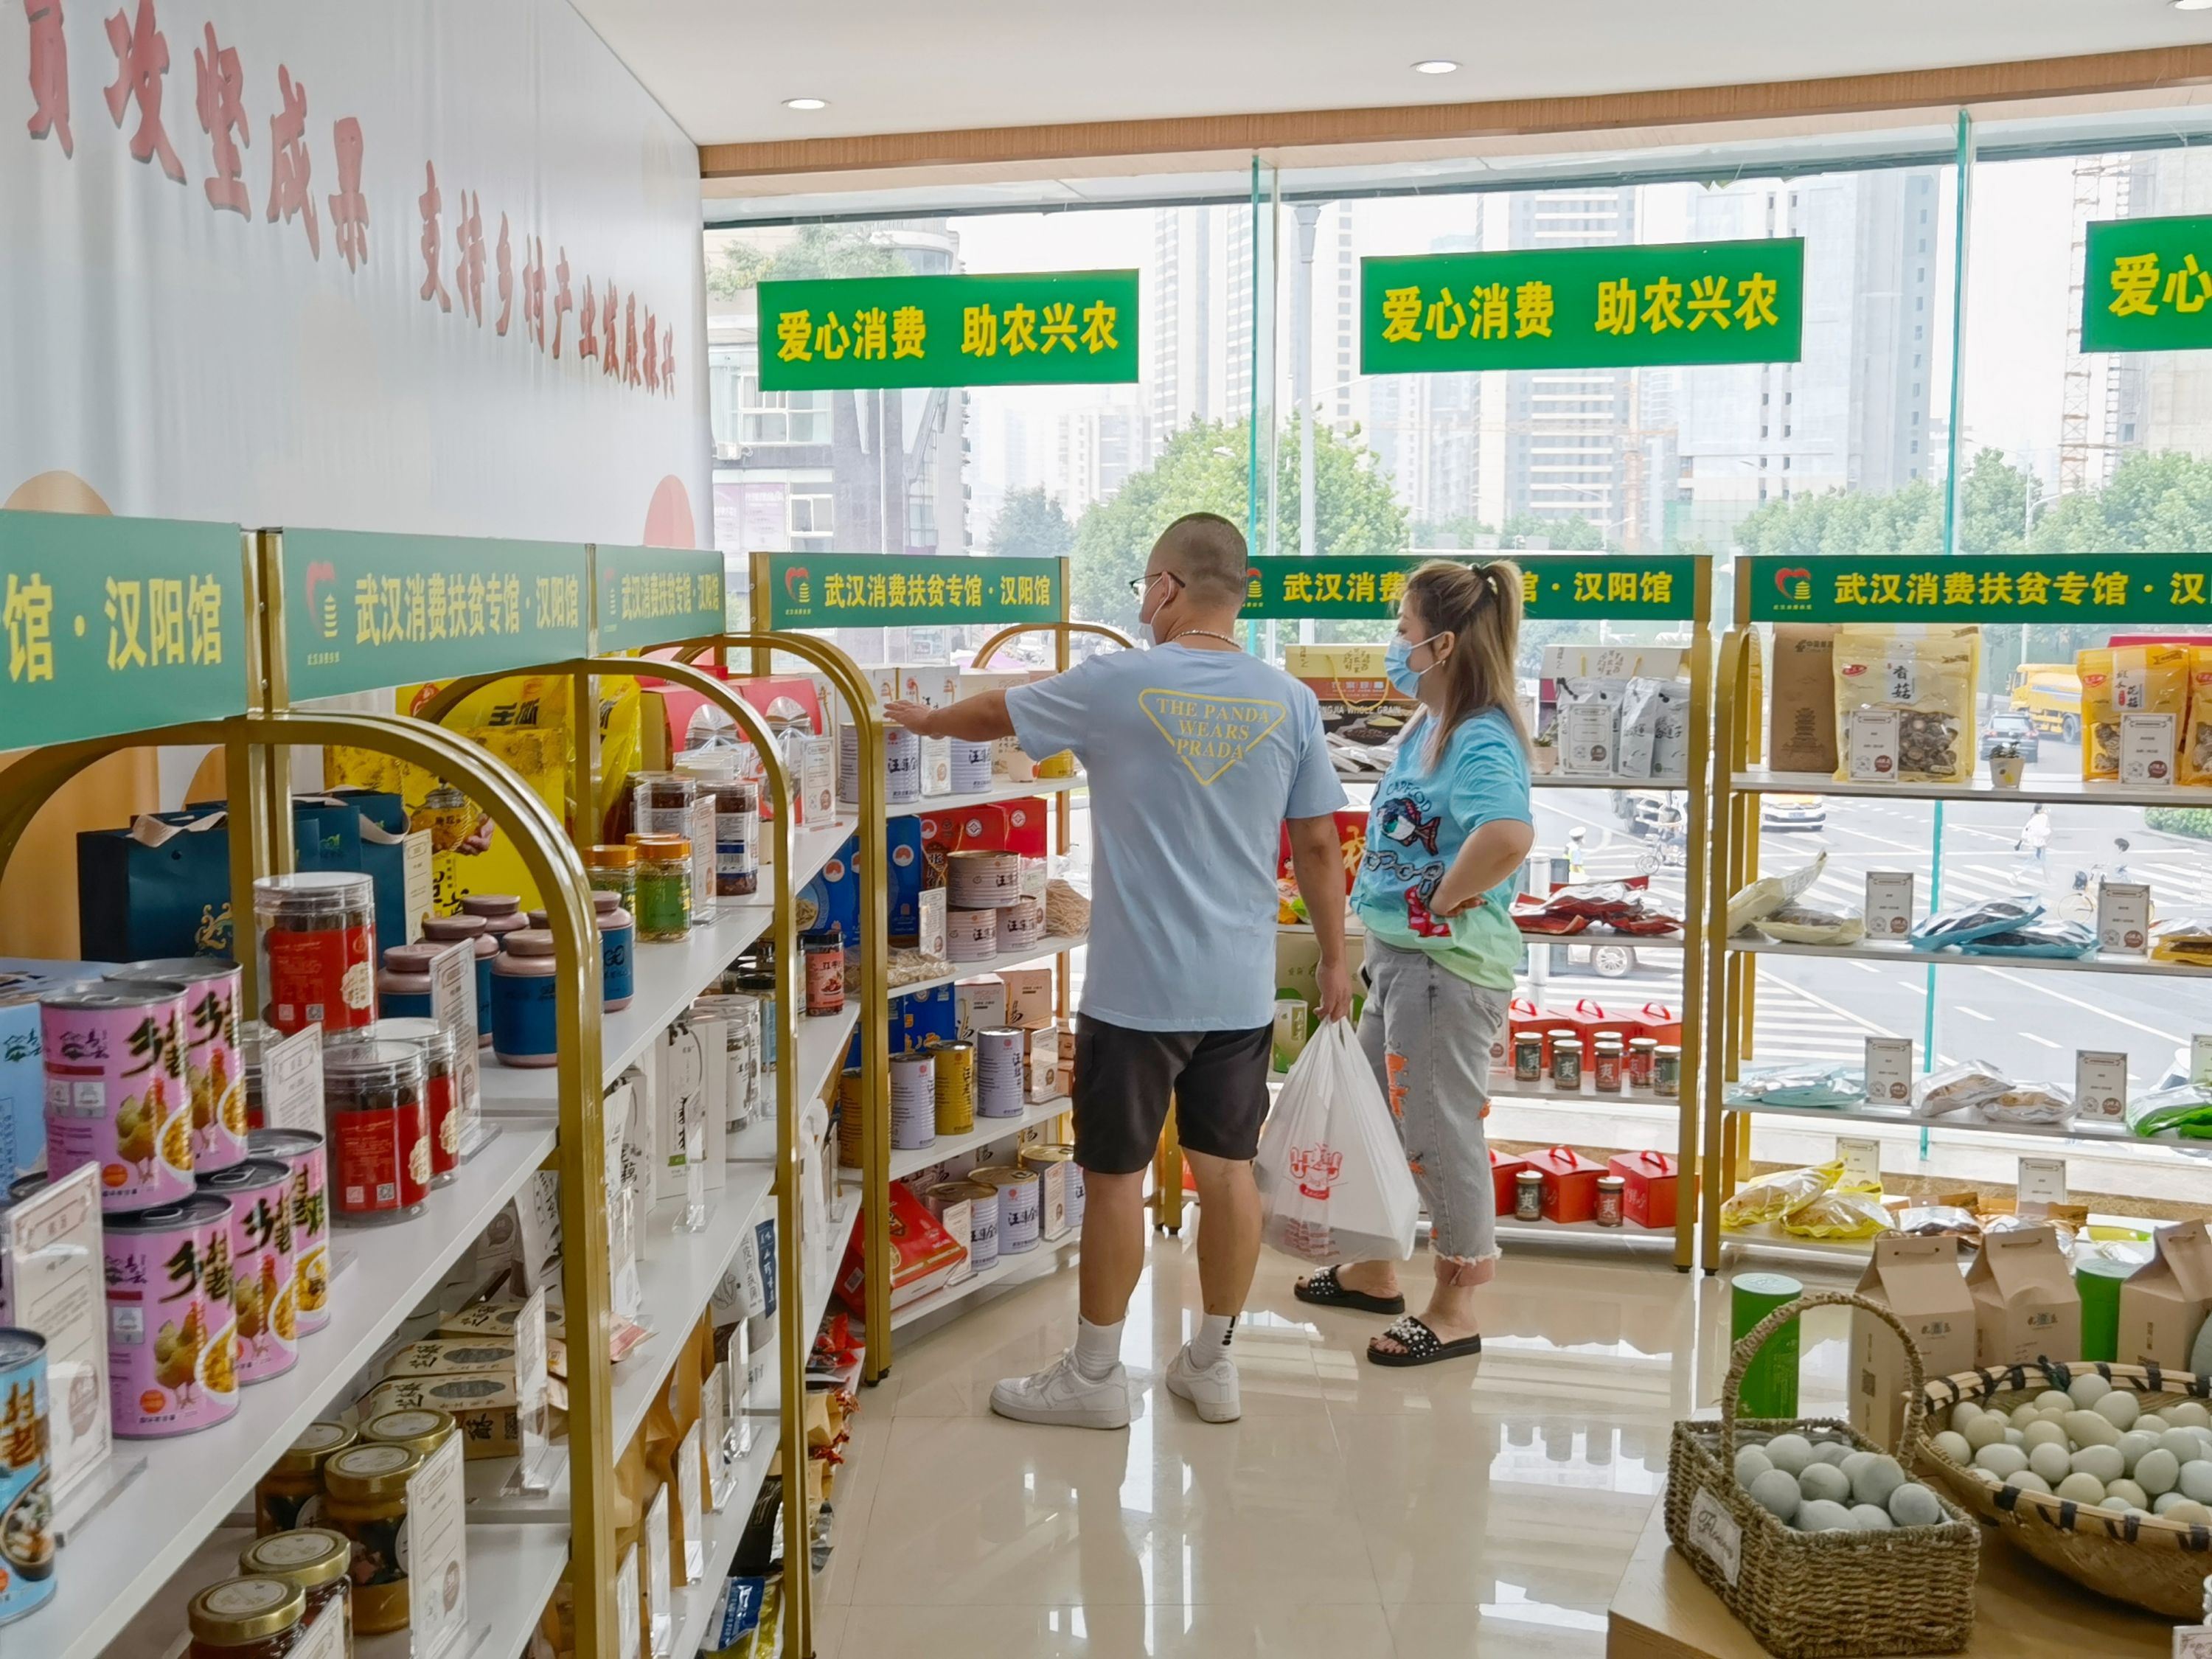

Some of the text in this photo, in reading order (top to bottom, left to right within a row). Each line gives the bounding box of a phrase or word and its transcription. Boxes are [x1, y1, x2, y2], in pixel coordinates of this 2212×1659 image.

[2109, 253, 2212, 317] 爱心
[1382, 272, 1779, 344] 爱心消费 助农兴农
[776, 299, 1119, 362] 爱心消费 助农兴农
[1892, 665, 1913, 700] 香菇
[1156, 698, 1270, 724] THE PANDA
[1377, 705, 1402, 715] GRAIN
[1178, 720, 1251, 740] WEARS
[1176, 738, 1245, 760] PRADA
[1560, 1062, 1576, 1077] 爽
[1599, 1062, 1614, 1079] 爽
[1520, 1192, 1535, 1209] 爽
[1601, 1198, 1618, 1216] 爽
